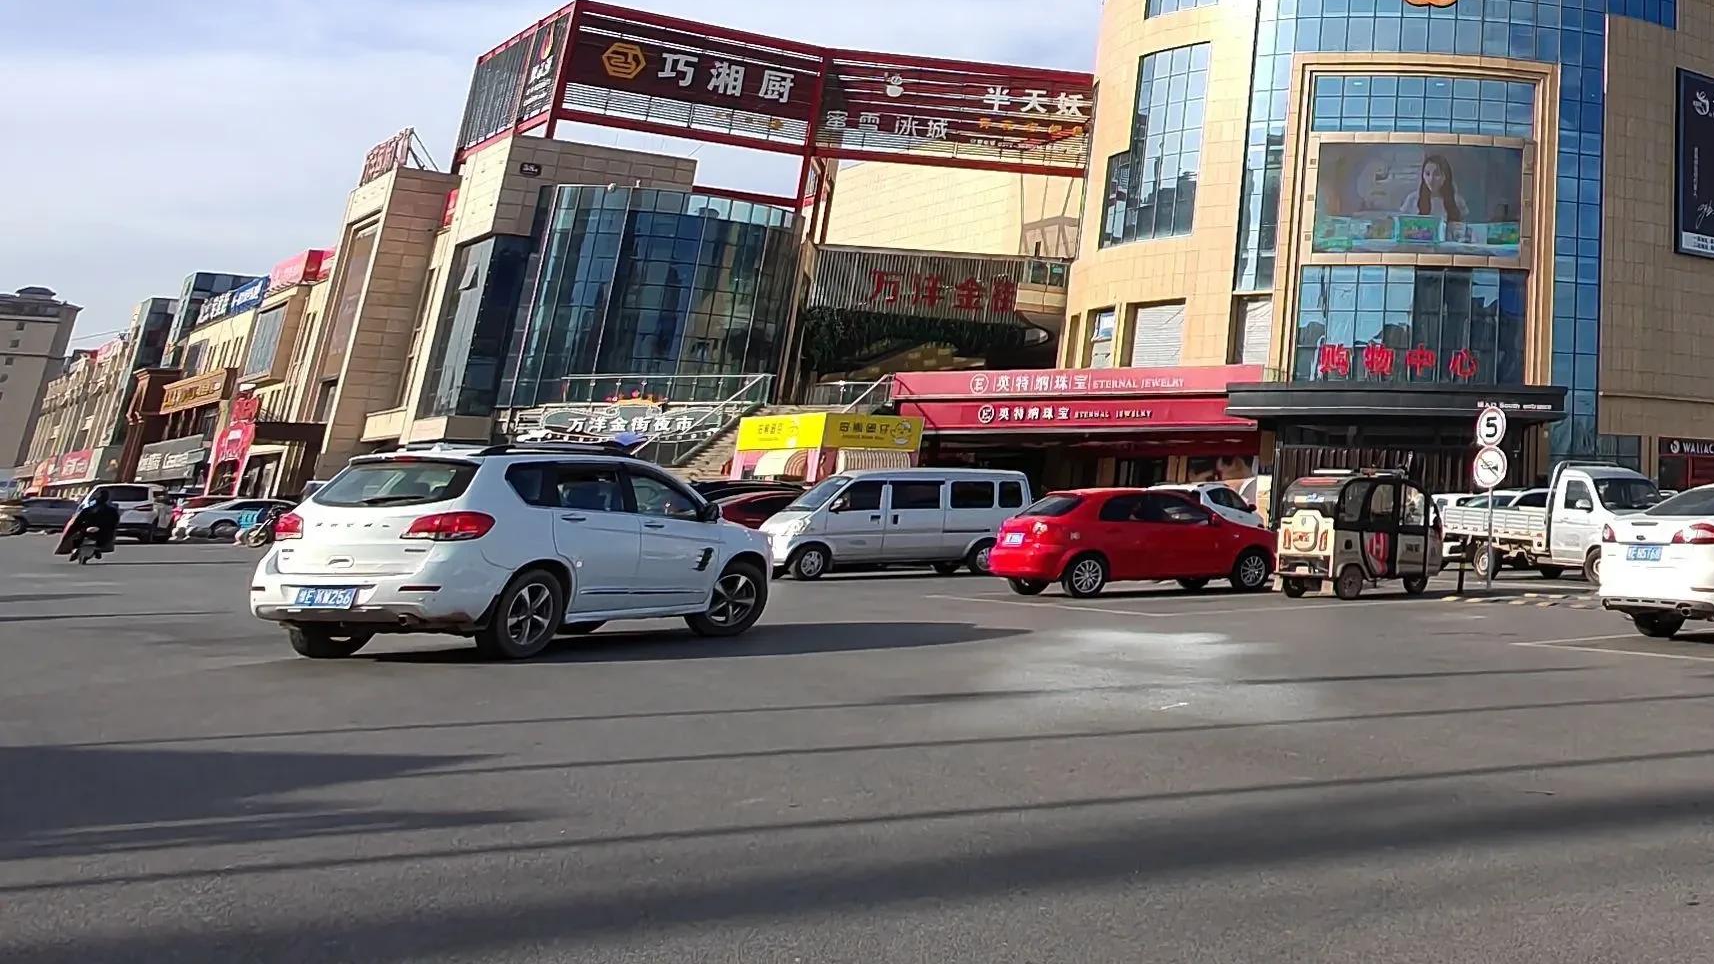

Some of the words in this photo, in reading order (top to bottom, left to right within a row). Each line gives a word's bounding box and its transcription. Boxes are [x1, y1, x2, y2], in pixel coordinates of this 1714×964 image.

[658, 52, 795, 103] 巧湘厨
[983, 87, 1084, 116] 半天妖
[825, 111, 948, 140] 蜜雪冰城
[1319, 342, 1478, 378] 购物中心
[995, 374, 1089, 391] 英特纳珠宝
[1093, 378, 1137, 389] ETERNAL
[1141, 377, 1184, 388] JEWELRY
[566, 416, 695, 433] 万洋金街夜市
[998, 407, 1069, 421] 英特纳珠宝
[1485, 416, 1498, 438] 5
